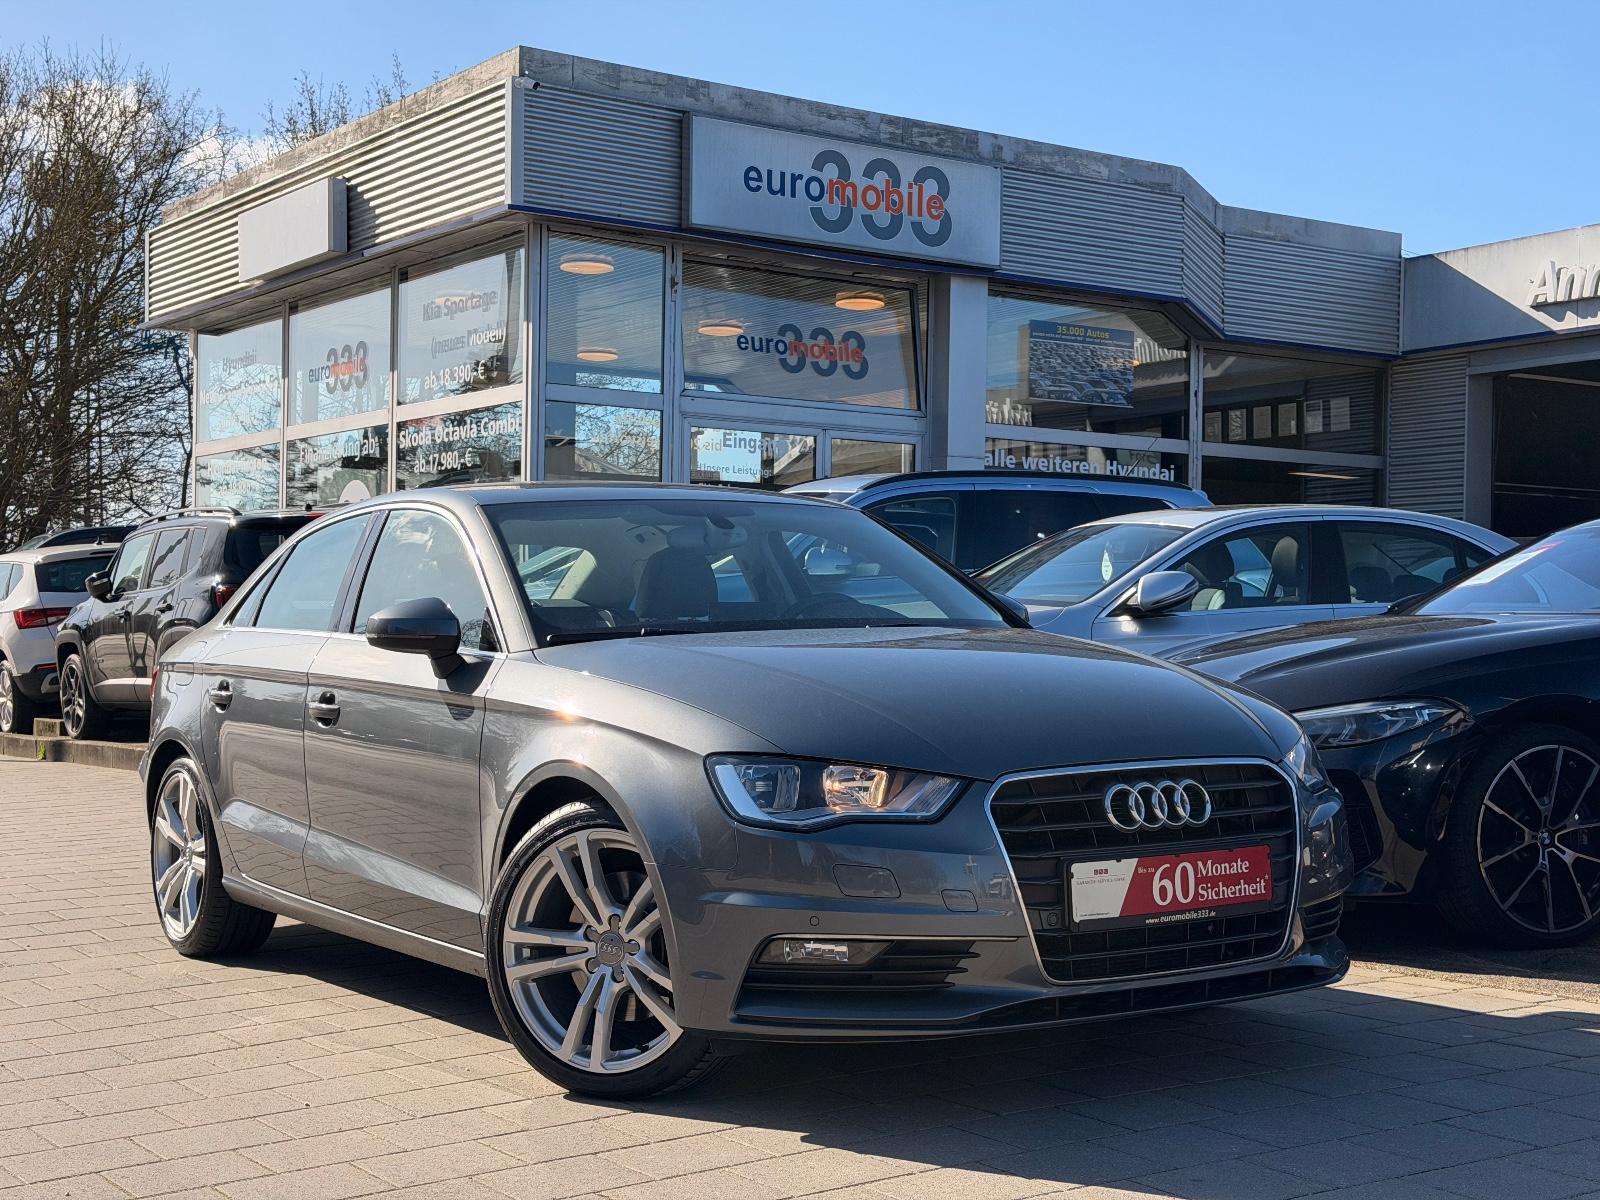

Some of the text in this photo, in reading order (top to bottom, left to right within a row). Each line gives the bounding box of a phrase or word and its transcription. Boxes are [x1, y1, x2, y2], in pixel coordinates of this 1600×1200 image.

[743, 164, 945, 221] euromobile
[808, 149, 953, 247] 333
[422, 290, 498, 321] Kia Sportage
[1056, 325, 1085, 336] 35.000
[1086, 329, 1110, 339] Autos
[736, 334, 864, 364] euromobile
[777, 323, 869, 381] 333
[308, 354, 368, 383] euromobile
[325, 340, 369, 395] 333
[424, 369, 437, 390] ab
[398, 427, 432, 449] Skoda
[434, 419, 478, 444] Octavia
[414, 455, 426, 474] ab
[984, 448, 1175, 482] alle weiteren Hyundai
[1196, 857, 1250, 878] Monate
[1152, 861, 1195, 906] 60
[1145, 909, 1217, 924] www.euromobile333.de
